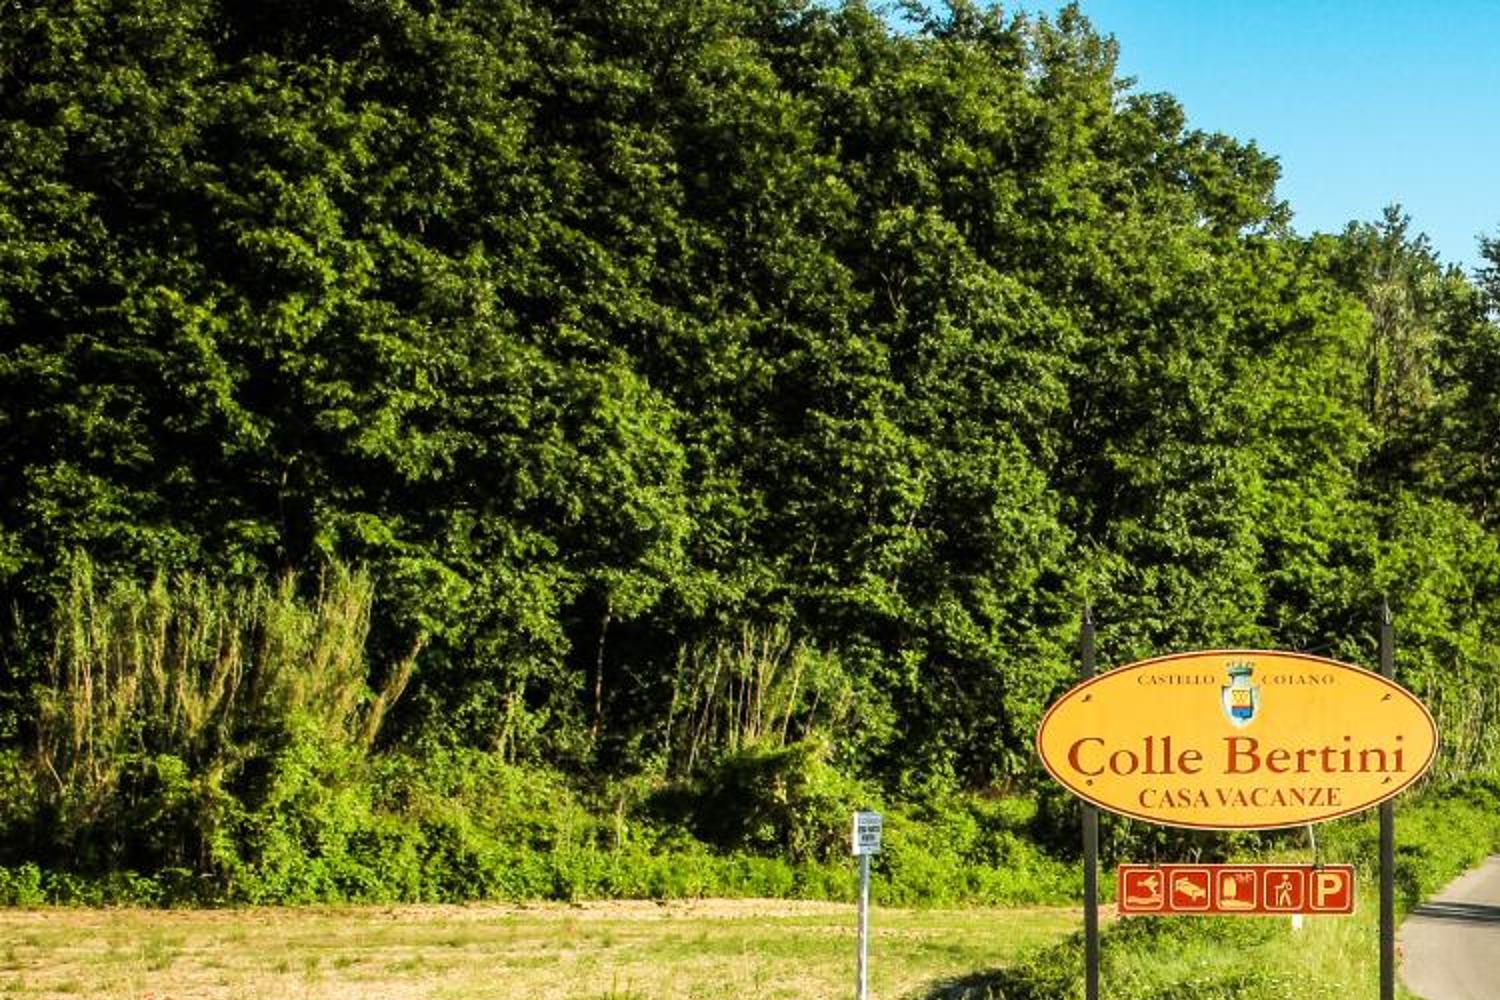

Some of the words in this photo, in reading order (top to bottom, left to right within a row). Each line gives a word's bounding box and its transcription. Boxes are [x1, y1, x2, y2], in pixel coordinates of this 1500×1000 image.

[1137, 674, 1215, 686] CASTELLO
[1261, 674, 1335, 686] COIANO
[1067, 735, 1204, 777] Colle
[1223, 735, 1406, 775] Bertini
[1139, 787, 1209, 809] CASA
[1216, 787, 1342, 808] VACANZE
[1317, 873, 1343, 907] P
